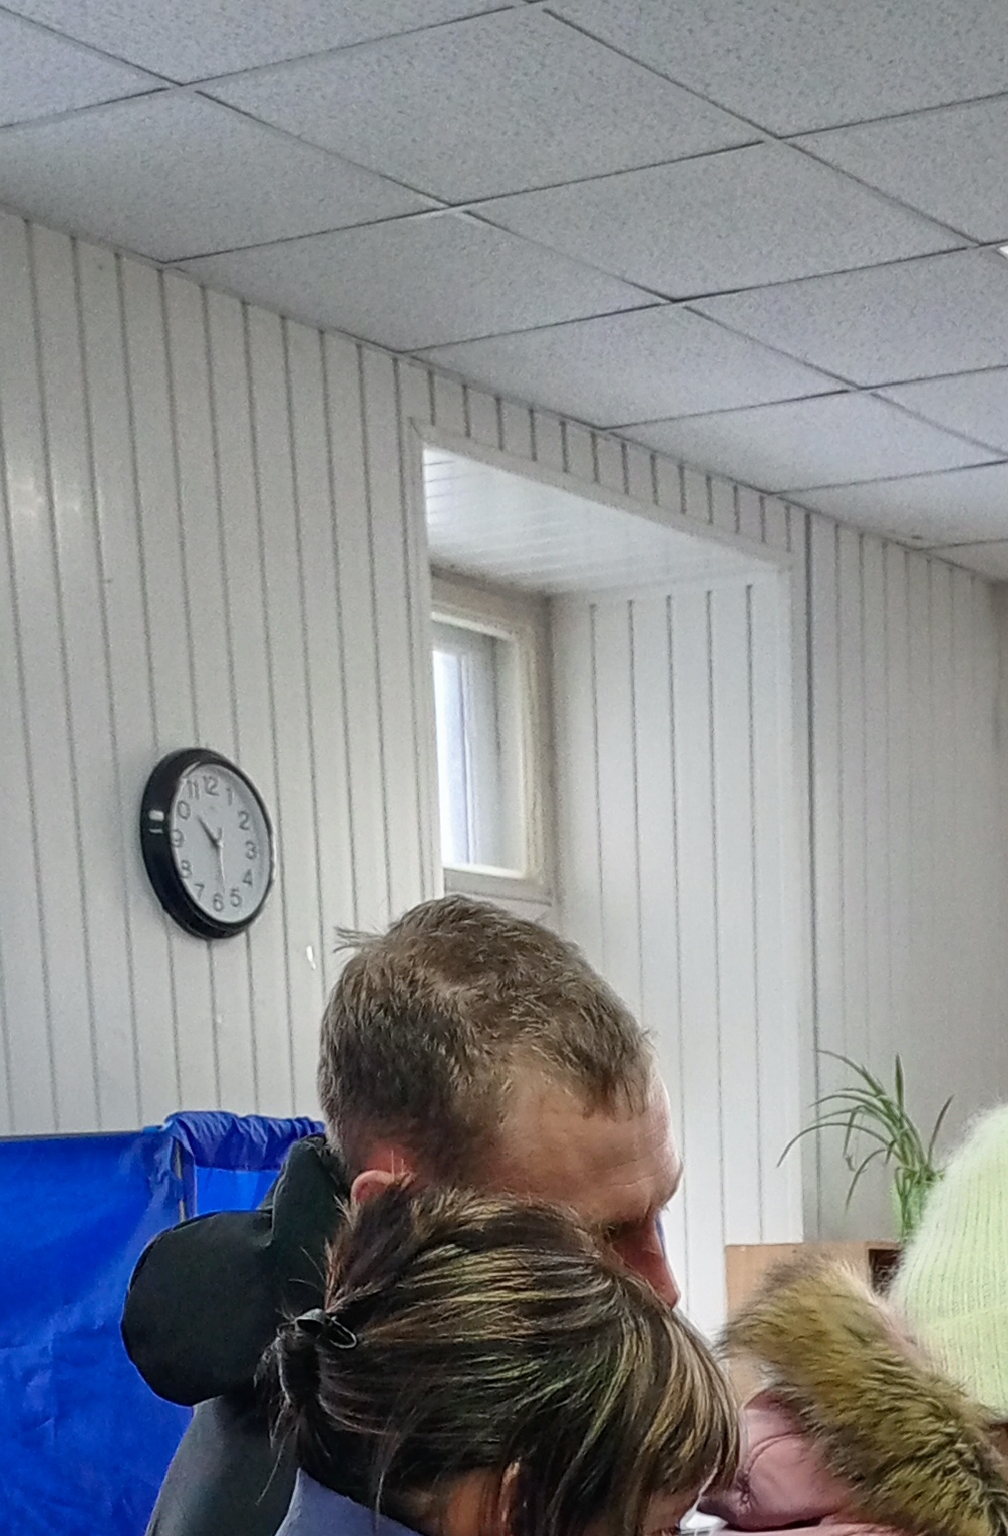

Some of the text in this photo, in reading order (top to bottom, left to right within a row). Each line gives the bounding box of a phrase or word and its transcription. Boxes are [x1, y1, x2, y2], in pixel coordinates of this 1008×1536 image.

[187, 780, 200, 800] 11
[203, 775, 220, 796] 12
[238, 811, 250, 830] 2
[245, 841, 257, 860] 3
[242, 869, 253, 888] 4
[194, 883, 205, 899] 7
[230, 888, 242, 907] 5
[213, 893, 225, 912] 6
